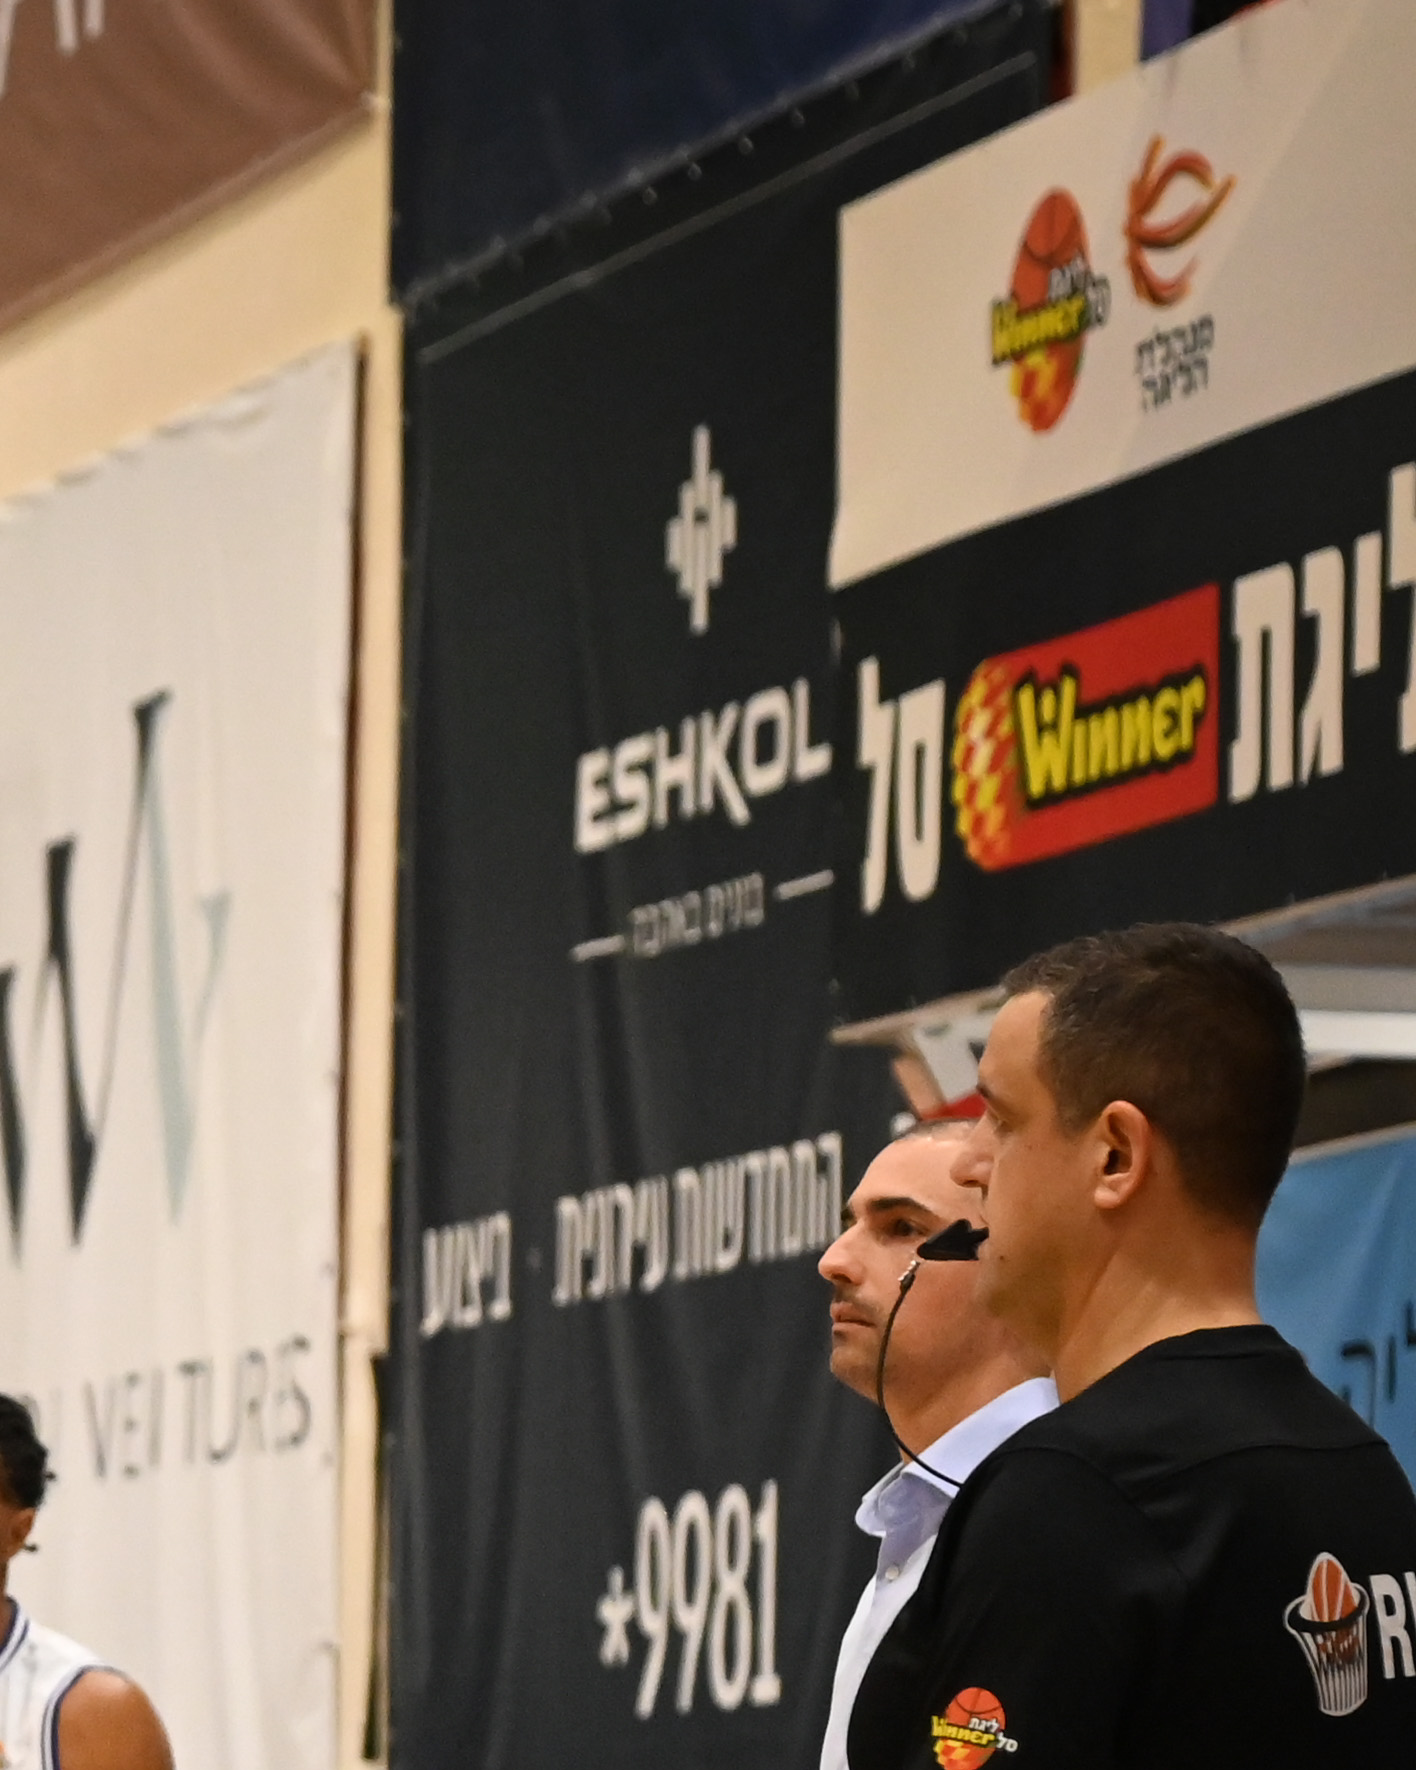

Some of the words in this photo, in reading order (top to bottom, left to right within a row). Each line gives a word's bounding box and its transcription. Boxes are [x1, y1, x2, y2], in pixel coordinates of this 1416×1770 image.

[573, 676, 833, 855] ESHKOL
[856, 655, 947, 916] סל
[1017, 674, 1206, 800] Winner
